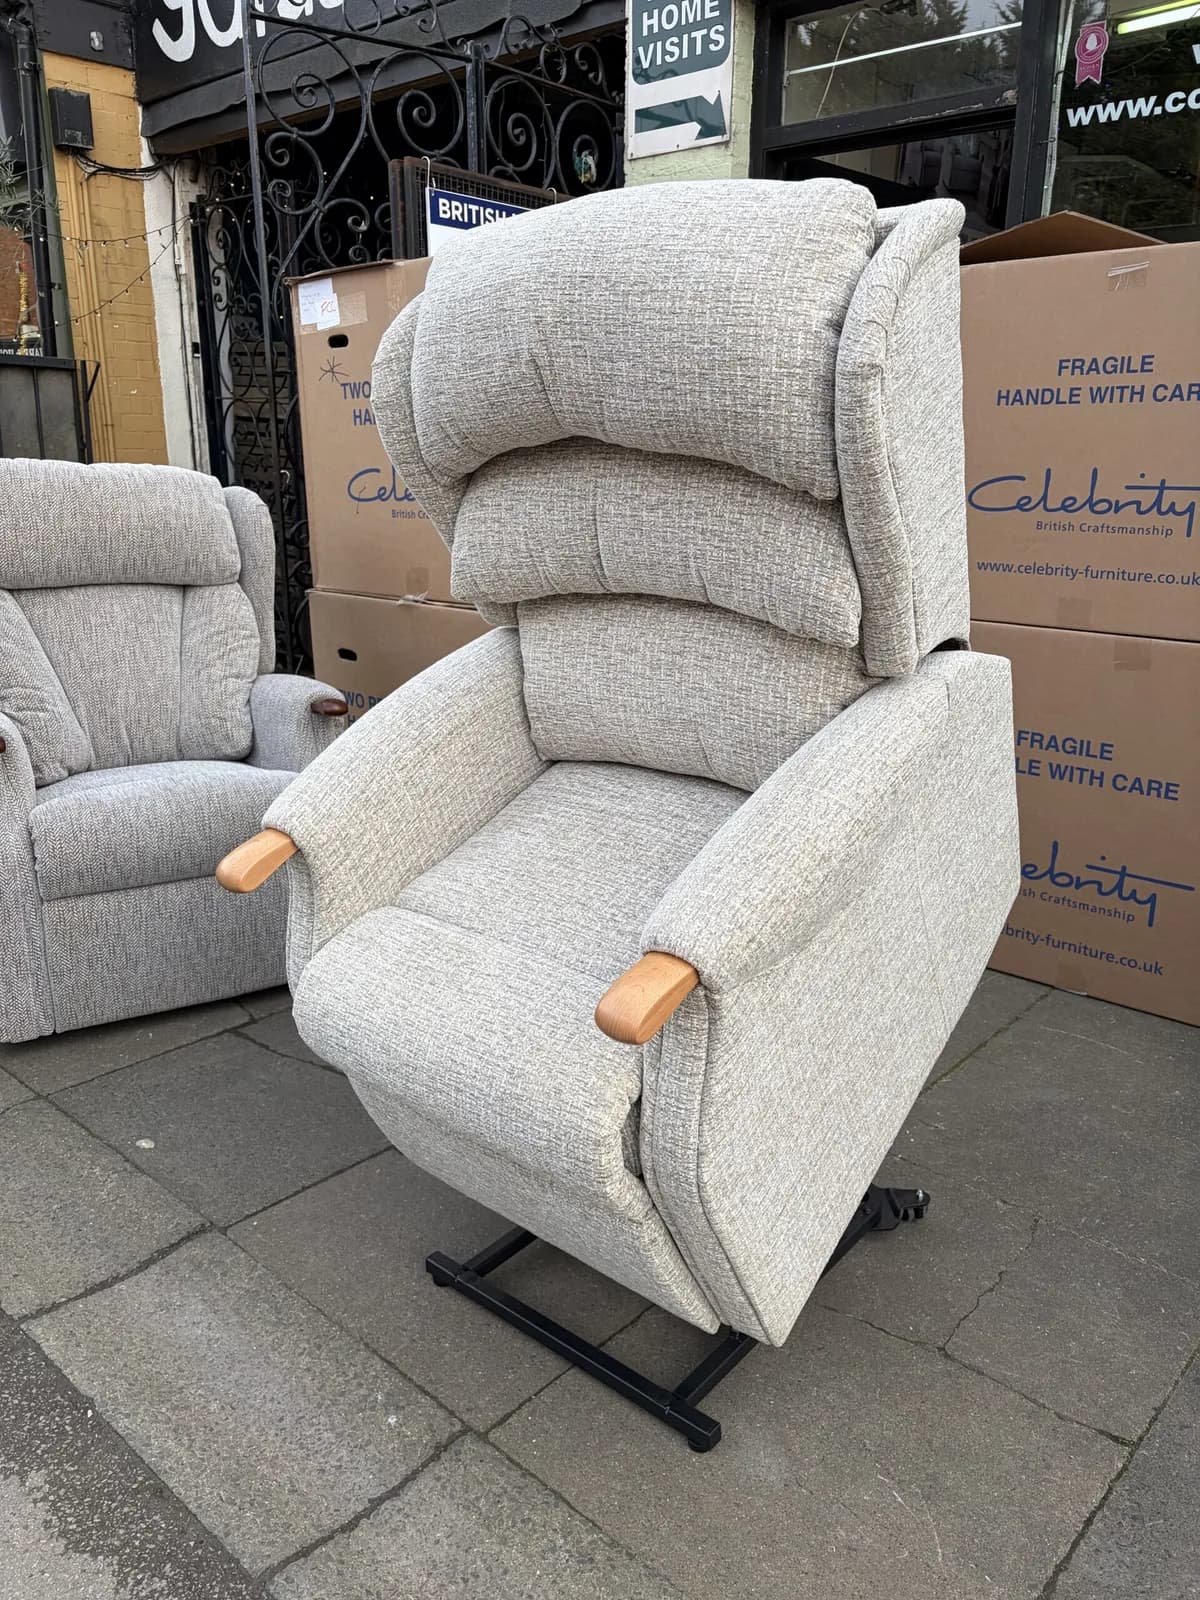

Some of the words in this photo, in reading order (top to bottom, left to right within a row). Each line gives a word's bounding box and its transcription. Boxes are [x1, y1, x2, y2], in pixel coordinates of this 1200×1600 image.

[643, 0, 720, 37] HOME
[638, 25, 725, 69] VISITS
[1066, 87, 1200, 127] www.co
[1057, 354, 1155, 376] FRAGILE
[341, 381, 372, 400] TWO
[996, 387, 1082, 406] HANDLE
[1089, 384, 1145, 404] WITH
[1152, 382, 1200, 403] CAR
[391, 508, 416, 520] British
[968, 467, 1200, 538] Celebrity
[1035, 520, 1075, 533] British
[1079, 522, 1174, 538] Craftsmanship
[977, 561, 1200, 586] www.celebrity-furniture.co.uk
[1016, 730, 1114, 761] FRAGILE
[1048, 762, 1104, 788] WITH
[1111, 773, 1180, 801] CARE
[1020, 840, 1195, 928] ebrity
[1040, 891, 1136, 923] Craftsmanship
[1001, 923, 1164, 976] brity-furniture.co.uk
